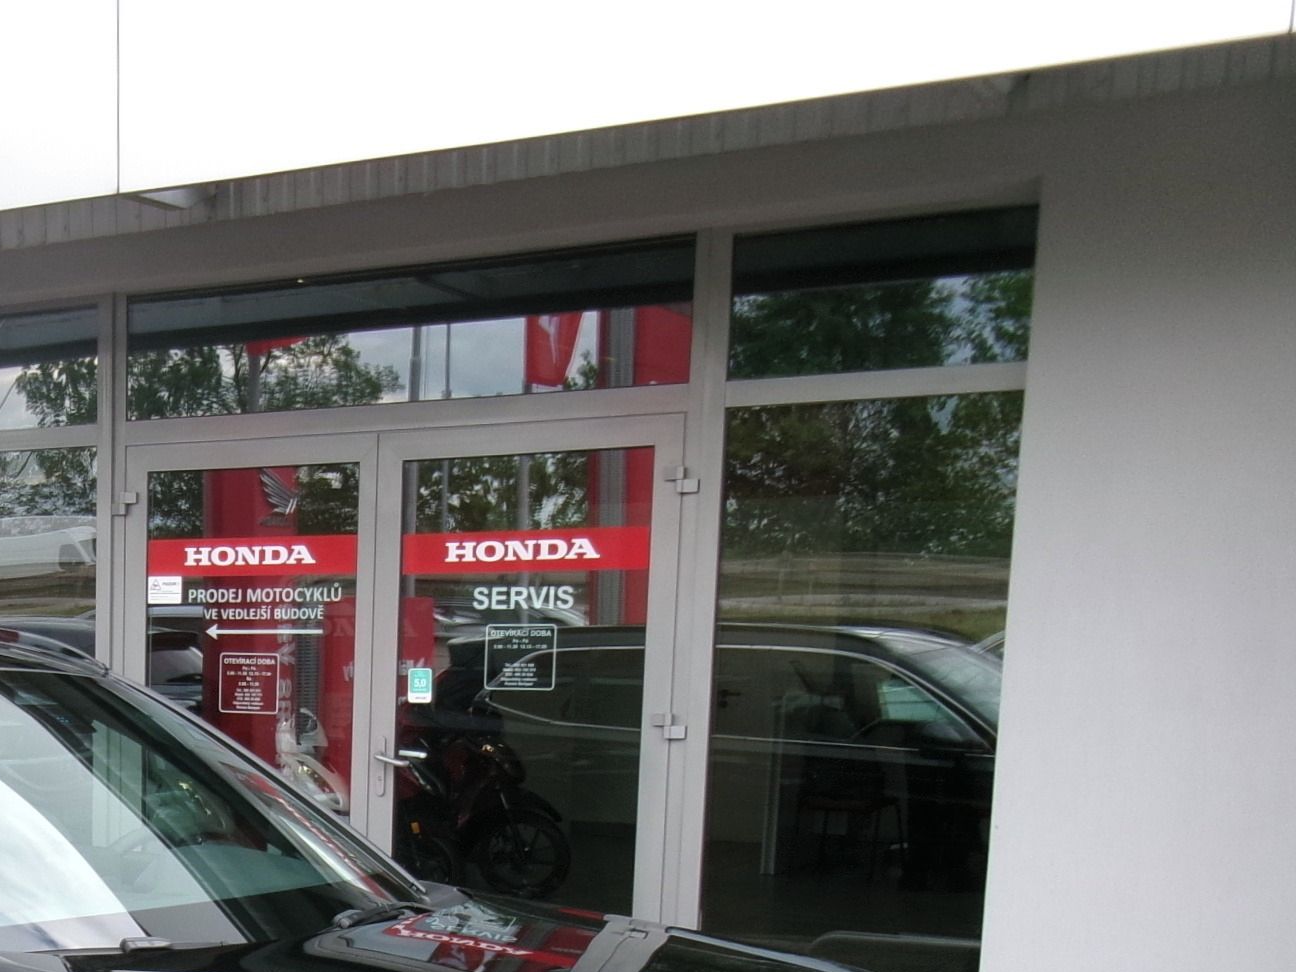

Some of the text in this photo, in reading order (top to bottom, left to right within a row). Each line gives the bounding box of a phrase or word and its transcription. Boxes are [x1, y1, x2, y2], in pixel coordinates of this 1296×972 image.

[184, 545, 316, 566] HONDA
[445, 538, 600, 562] HONDA
[188, 588, 242, 603] PRODEJ
[247, 582, 342, 602] MOTOCYKLŮ
[473, 585, 575, 610] SERVIS
[204, 604, 324, 620] VE VEDLEJŠÍ BUDOVĚ
